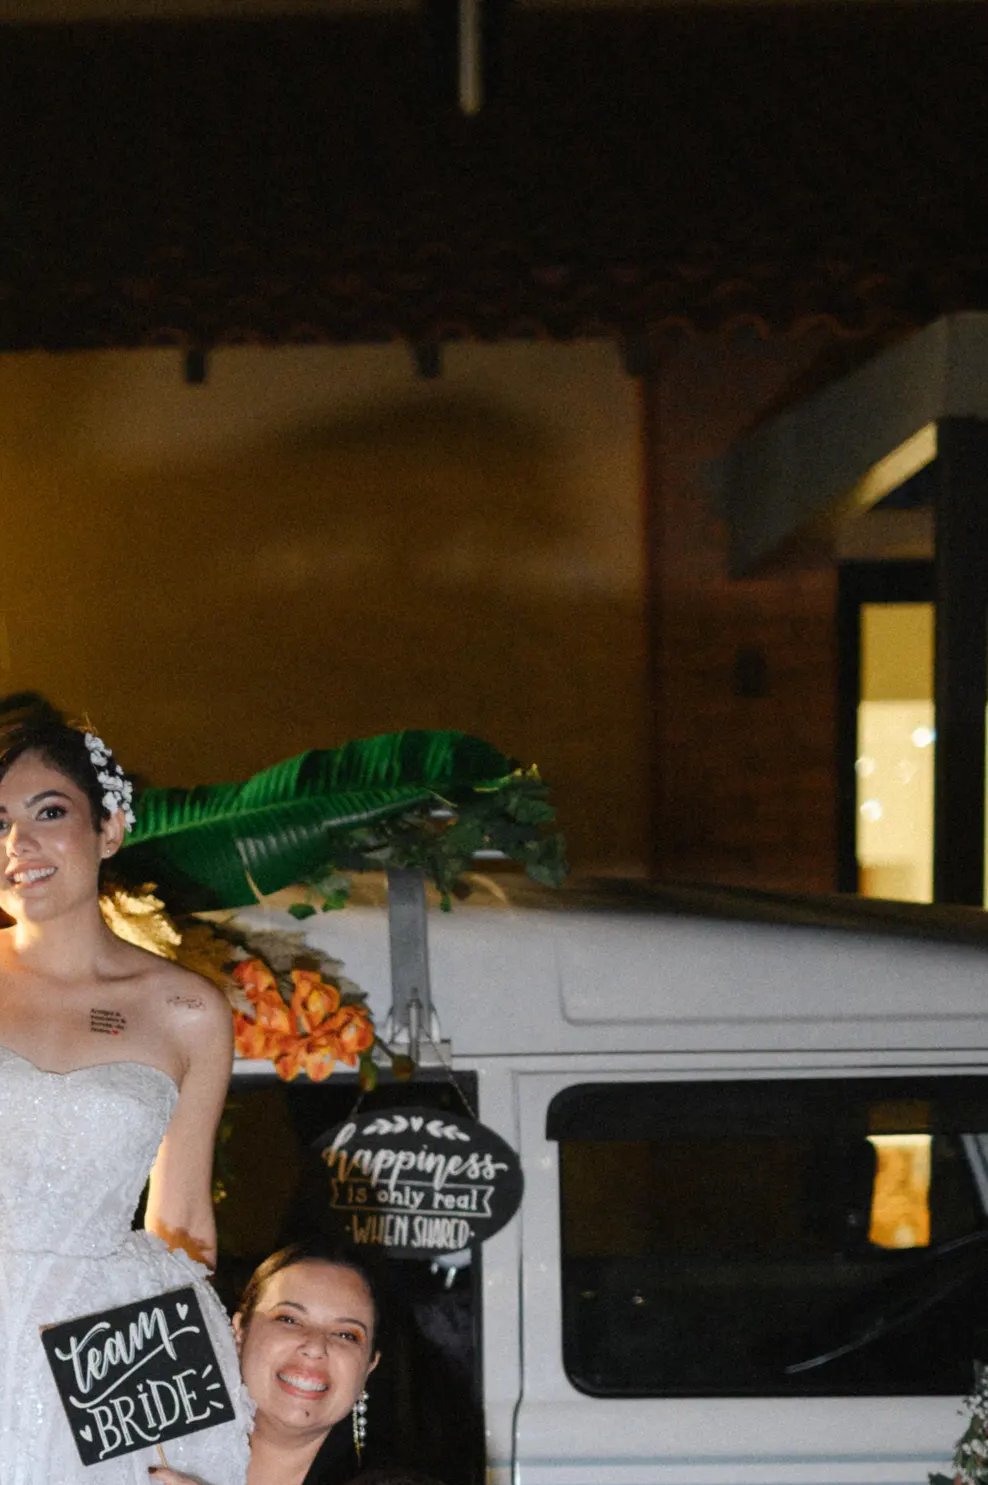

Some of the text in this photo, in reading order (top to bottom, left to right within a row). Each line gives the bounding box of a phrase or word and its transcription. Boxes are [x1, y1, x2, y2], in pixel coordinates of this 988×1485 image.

[322, 1122, 508, 1191] happiness
[377, 1186, 425, 1210] only
[432, 1189, 478, 1211] real
[352, 1214, 470, 1250] WHEN SHARED
